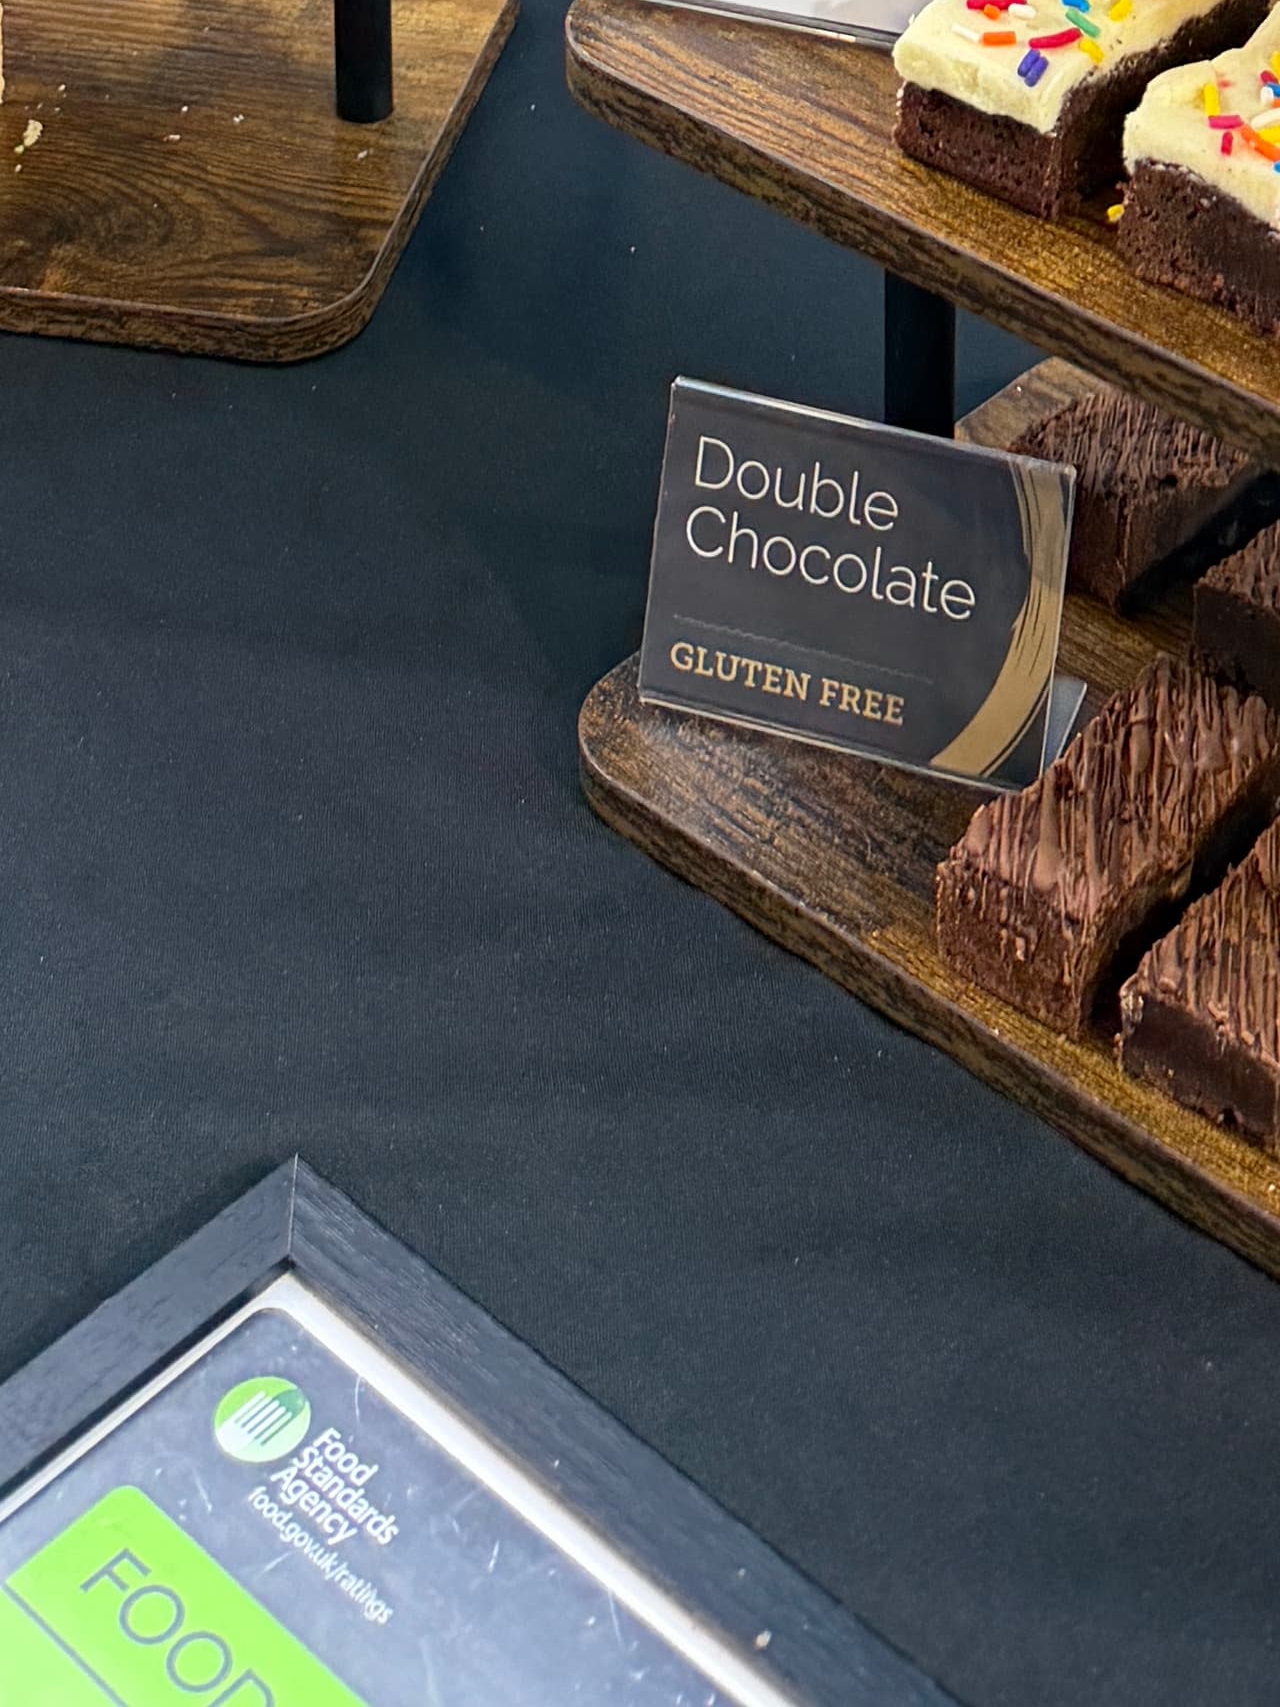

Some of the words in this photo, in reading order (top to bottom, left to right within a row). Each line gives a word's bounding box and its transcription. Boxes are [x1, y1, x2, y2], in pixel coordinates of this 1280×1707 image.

[694, 435, 899, 531] Double
[686, 505, 976, 620] Chocolate
[670, 641, 811, 702] GLUTEN
[819, 677, 905, 726] FREE
[291, 1445, 400, 1545] Standards
[313, 1427, 379, 1486] Food
[270, 1465, 358, 1546] Agency
[247, 1485, 394, 1625] food.gov.uk/ratings
